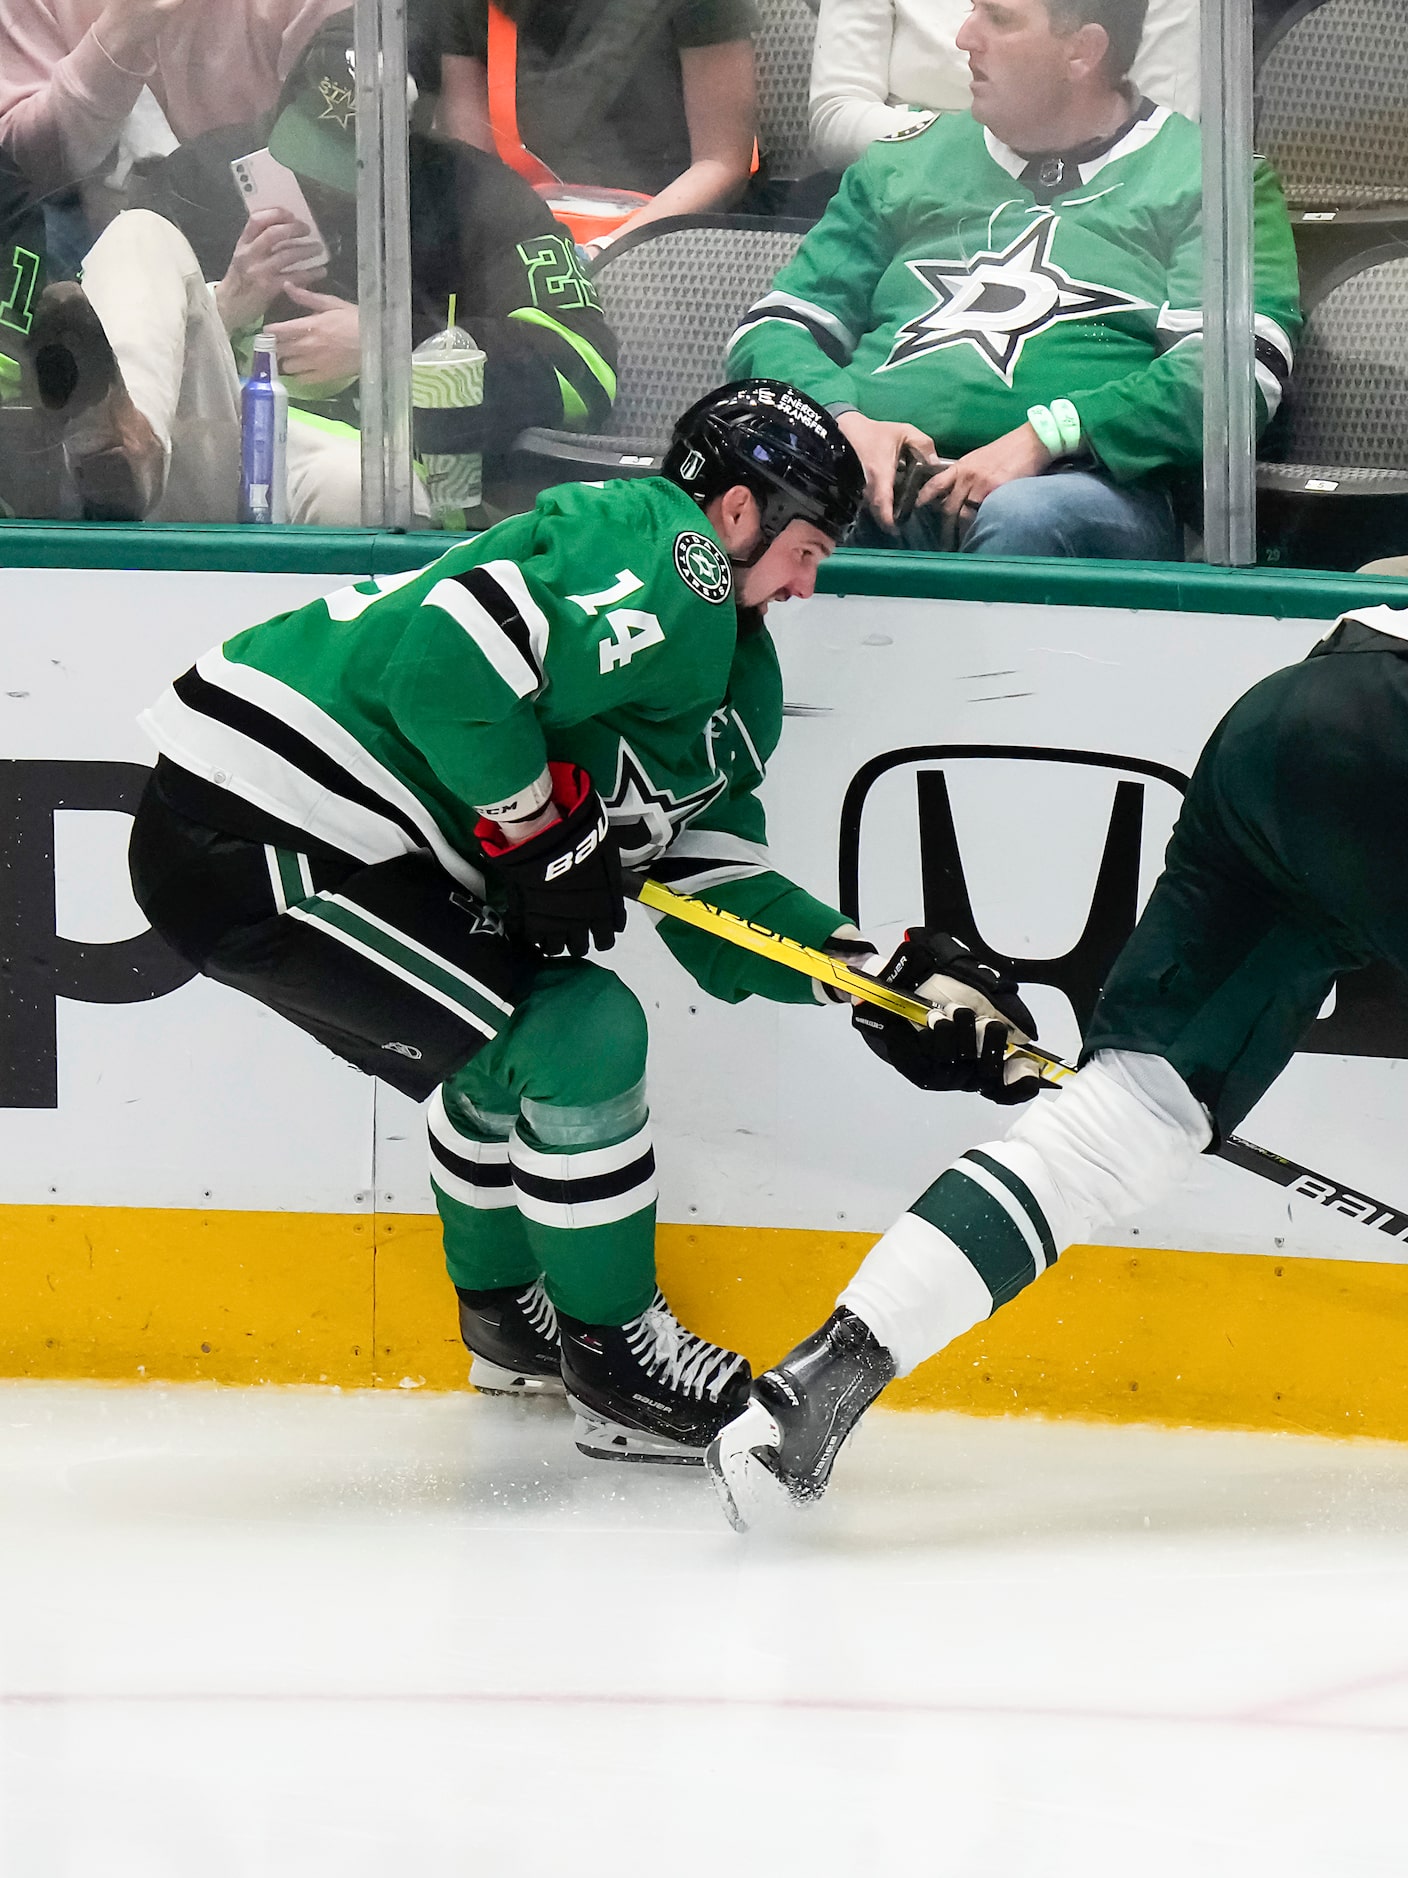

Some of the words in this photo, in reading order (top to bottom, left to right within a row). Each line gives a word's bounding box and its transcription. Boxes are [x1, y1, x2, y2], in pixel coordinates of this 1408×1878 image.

[777, 403, 829, 439] TRANSFER
[780, 392, 823, 422] ENERGY
[564, 568, 666, 675] 14
